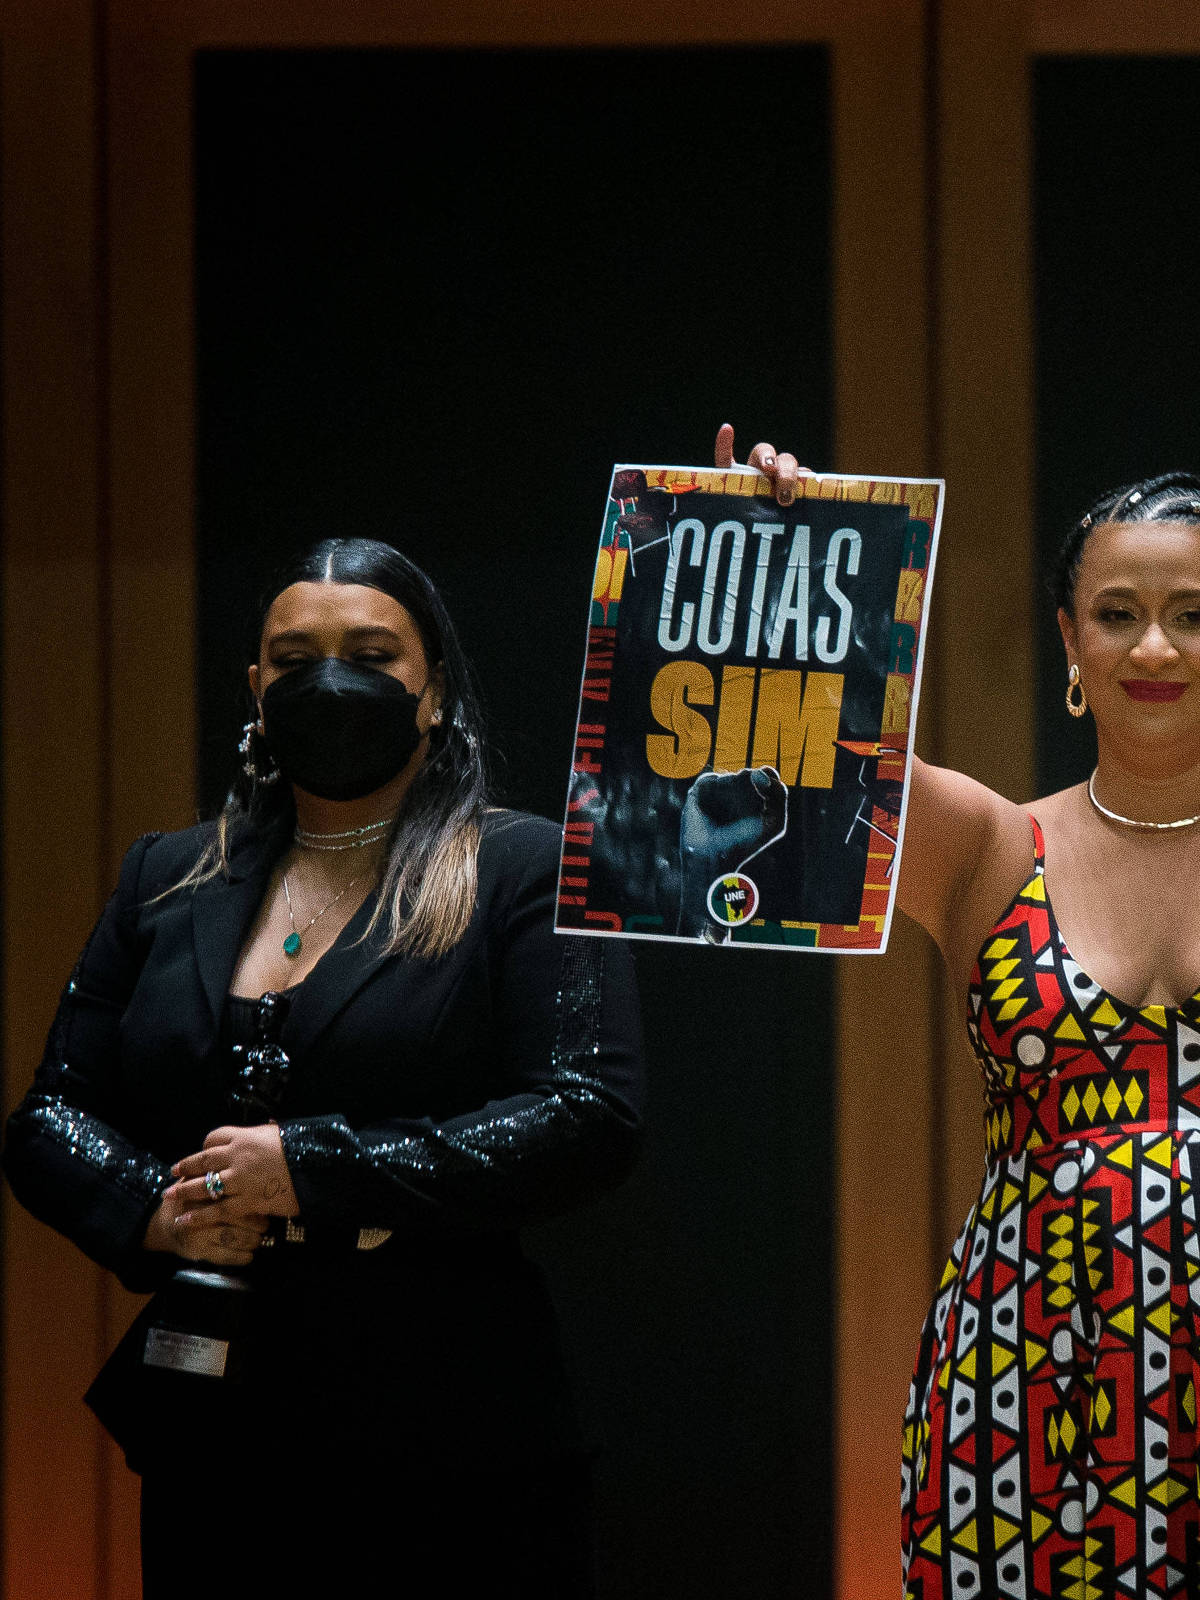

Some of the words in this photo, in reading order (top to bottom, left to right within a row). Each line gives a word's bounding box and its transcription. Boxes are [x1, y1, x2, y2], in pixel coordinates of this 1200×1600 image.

[658, 518, 862, 664] COTAS
[646, 660, 845, 788] SIM
[724, 890, 746, 902] UNE
